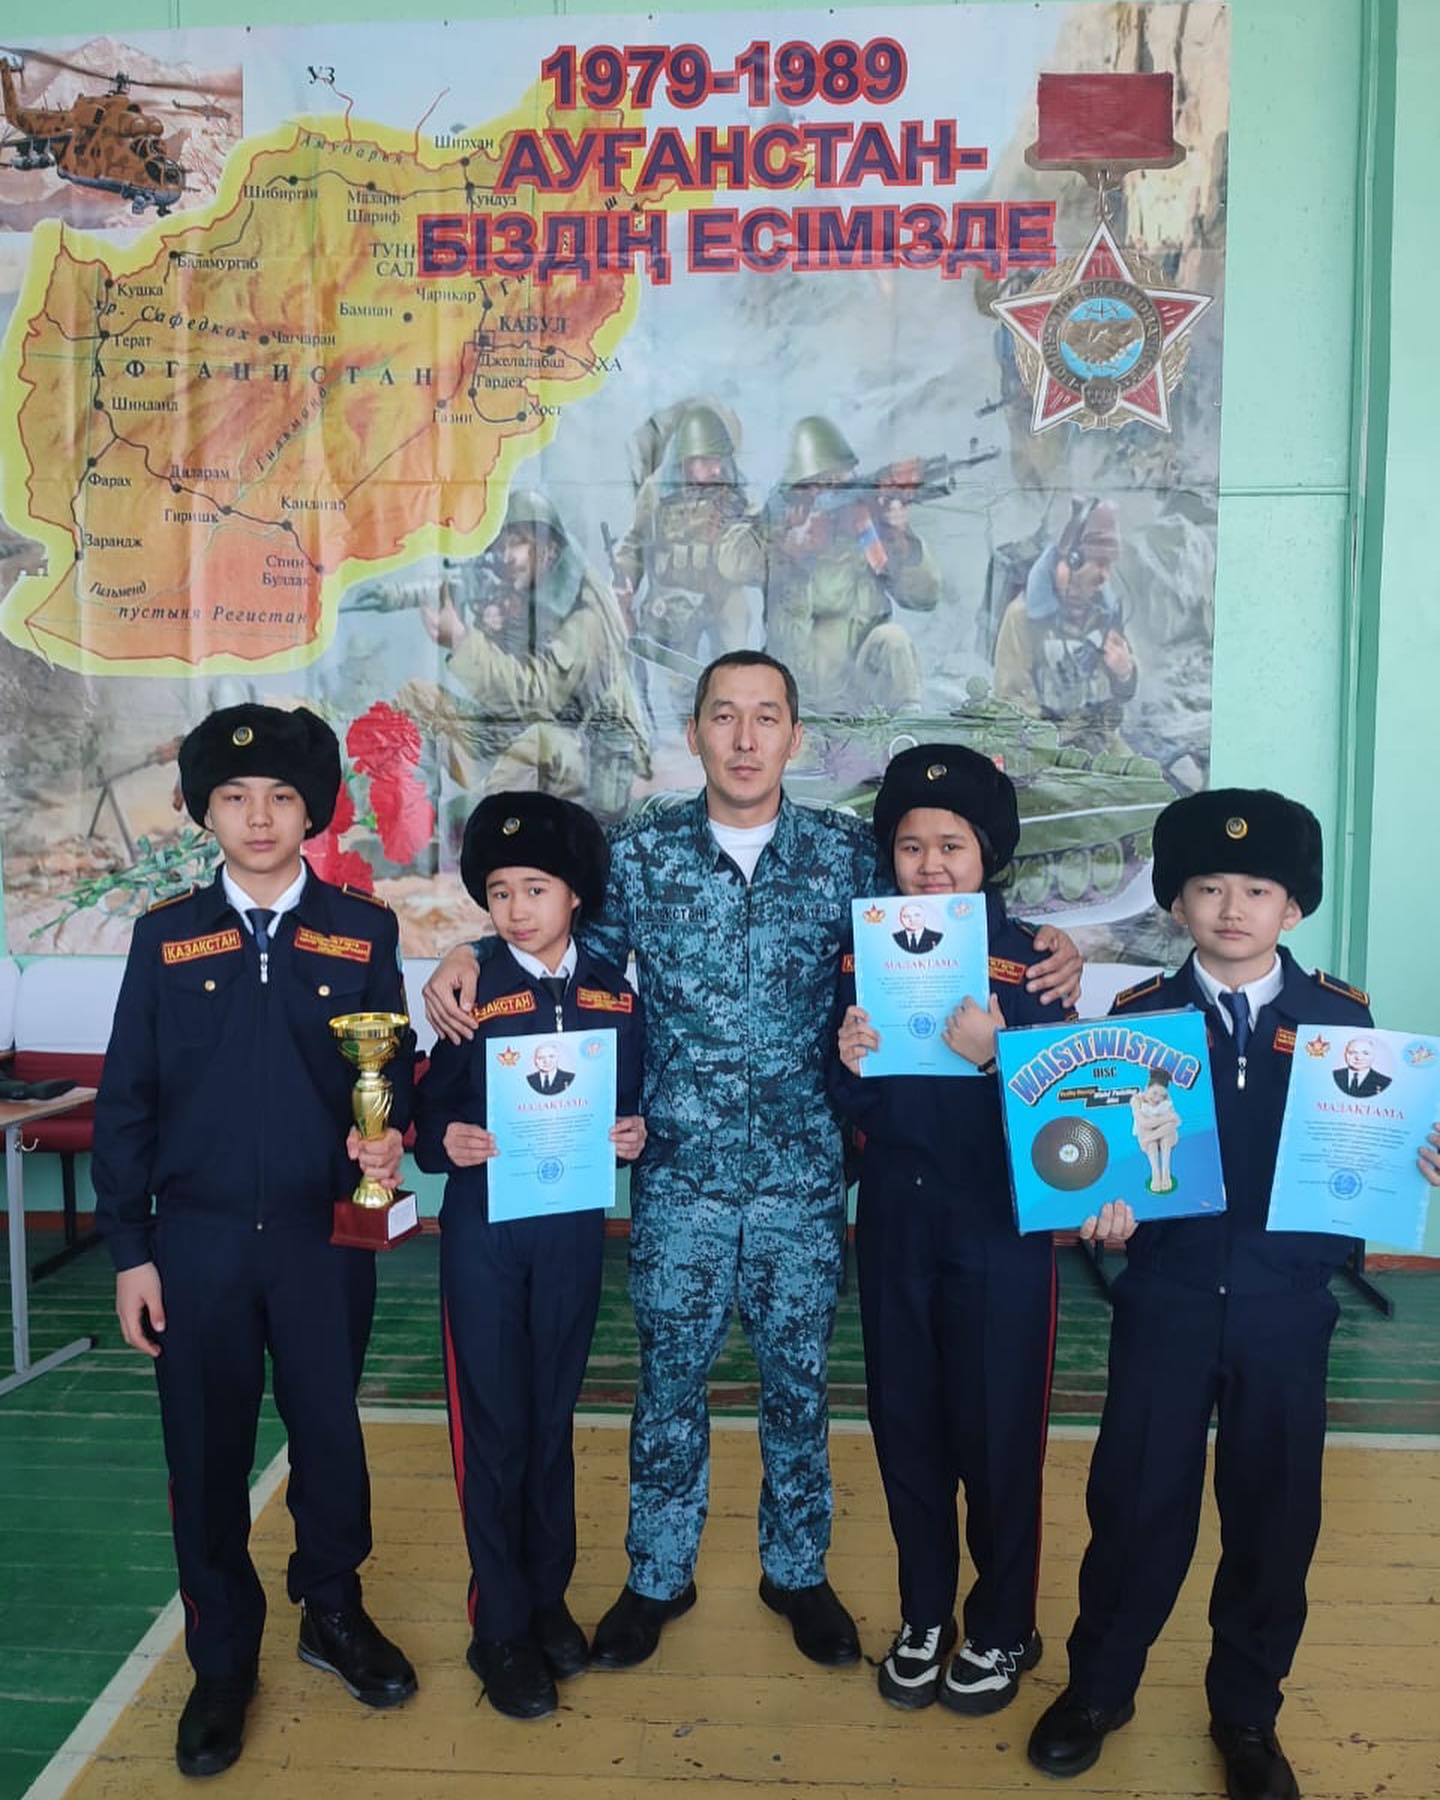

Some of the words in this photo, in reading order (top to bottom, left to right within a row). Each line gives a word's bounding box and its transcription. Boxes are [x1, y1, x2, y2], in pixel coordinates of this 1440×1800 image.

[541, 36, 908, 110] 1979-1989
[417, 209, 671, 285] БІЗДІҢ
[687, 201, 1056, 280] ЕСІМІЗДЕ
[117, 284, 163, 299] Кушка
[499, 316, 567, 333] КАБУЛ
[92, 359, 433, 386] АФГАНИСТАН
[88, 473, 132, 489] Фарах
[84, 533, 144, 549] Зарандж
